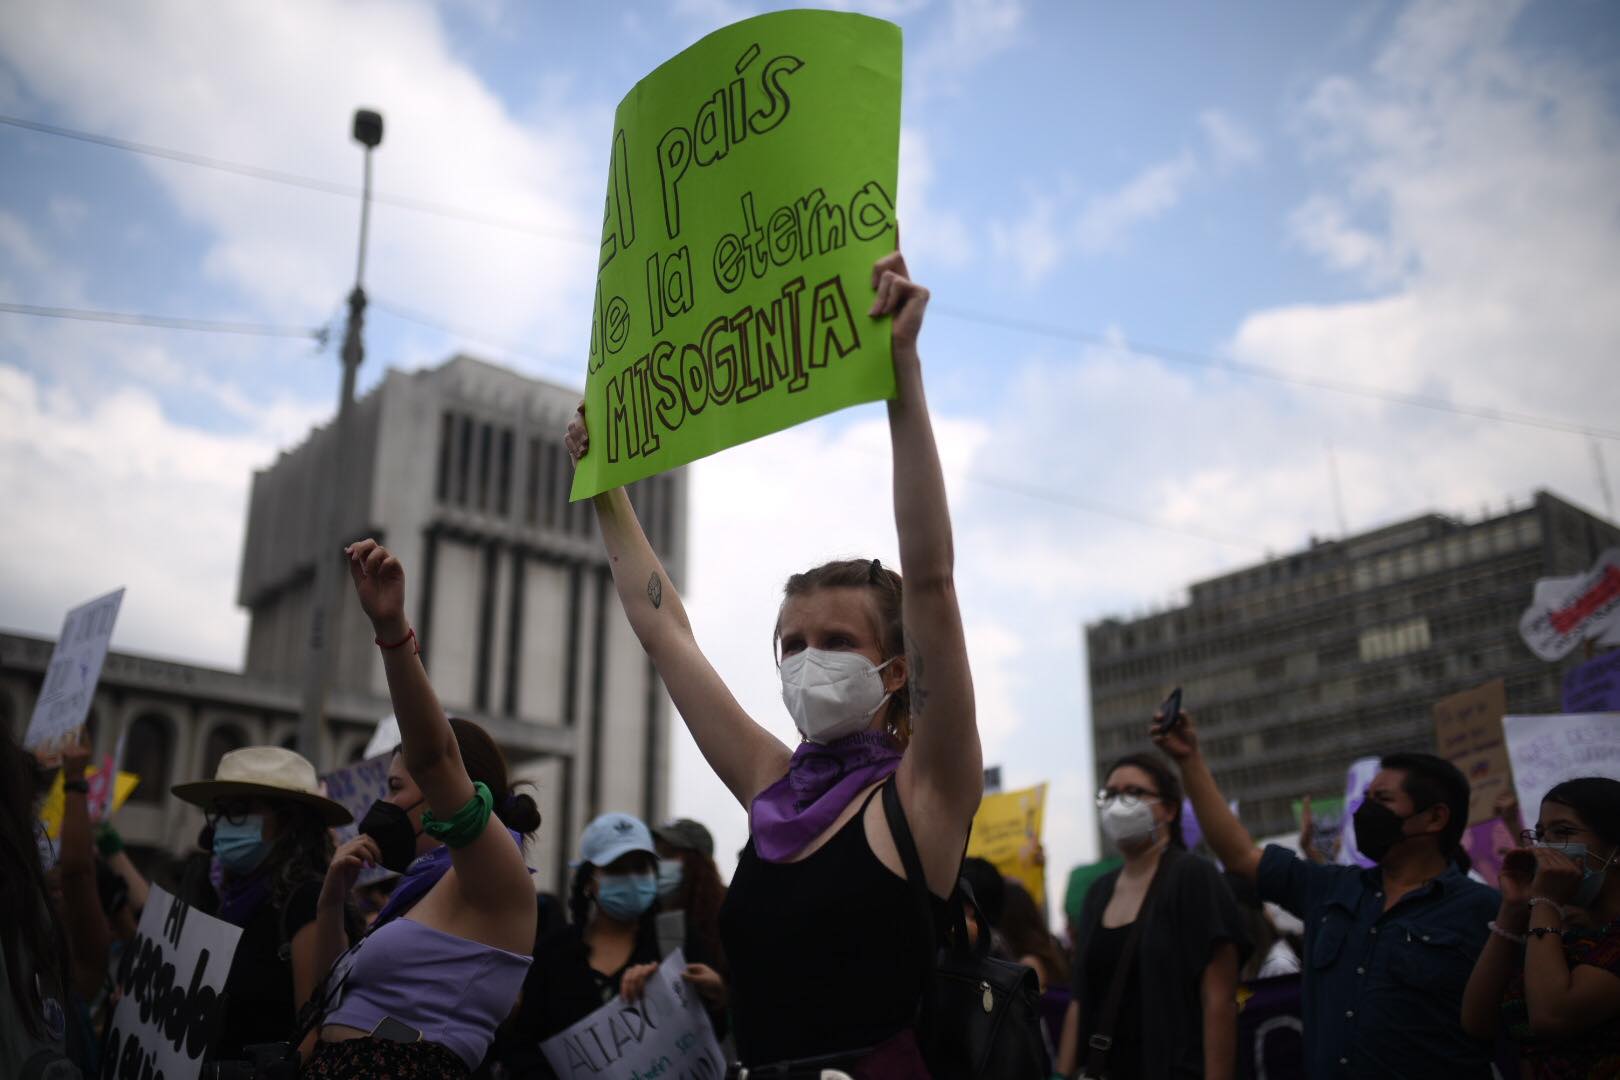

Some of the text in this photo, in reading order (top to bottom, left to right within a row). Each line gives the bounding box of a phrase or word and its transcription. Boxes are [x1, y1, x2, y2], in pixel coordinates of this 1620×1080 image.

[655, 43, 805, 239] país
[588, 181, 895, 375] de la eterna
[606, 275, 861, 464] MISOGINIA
